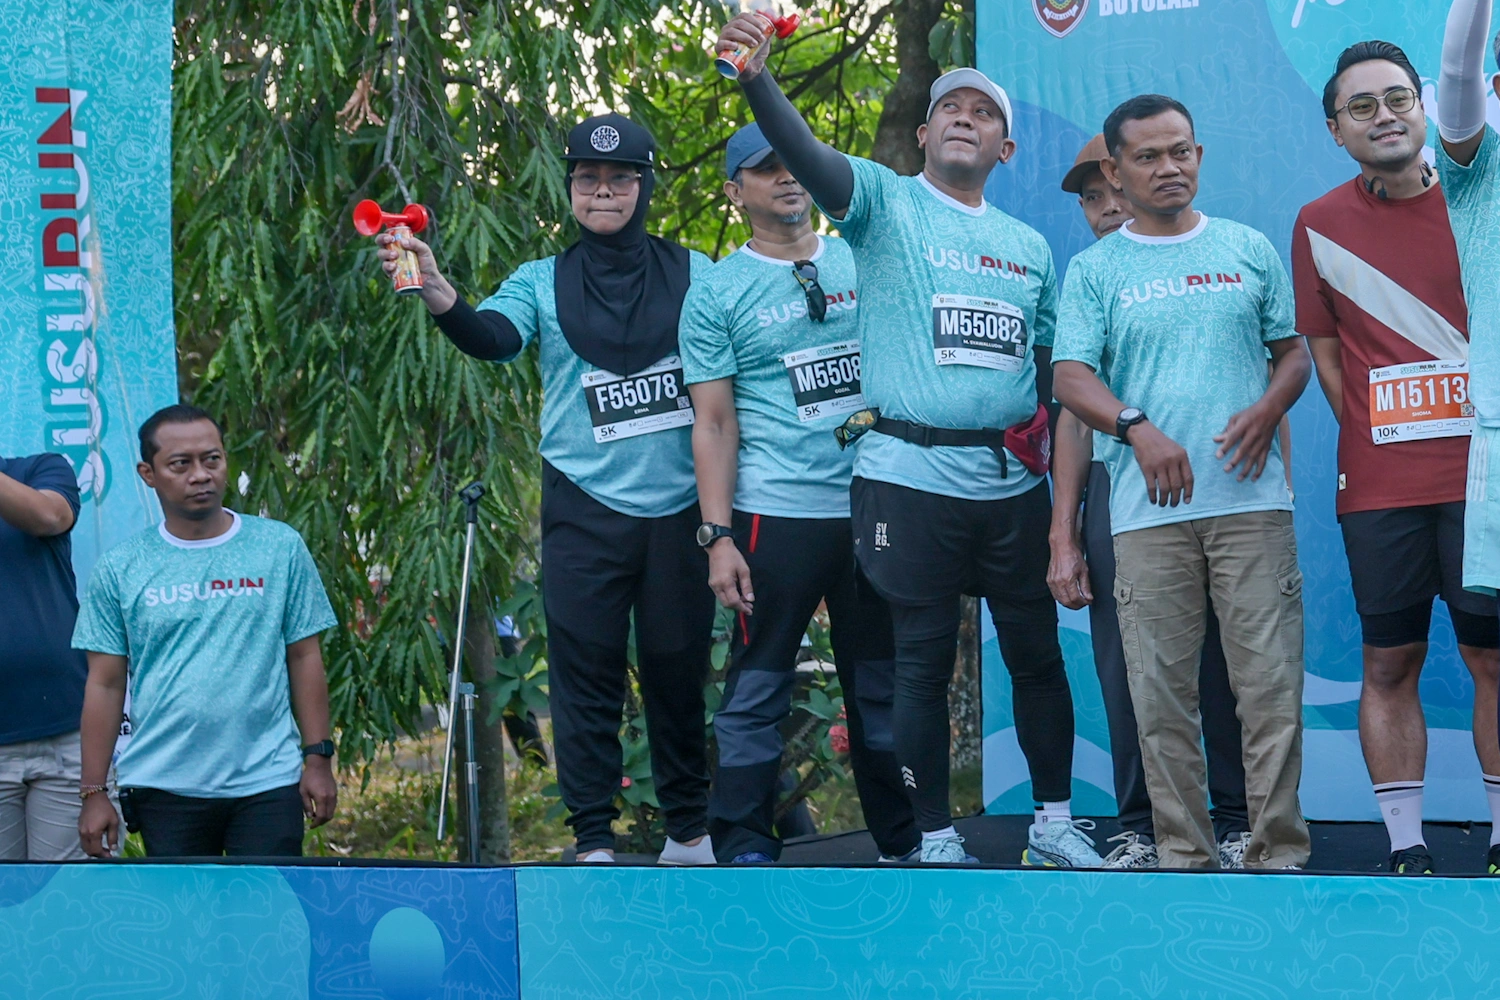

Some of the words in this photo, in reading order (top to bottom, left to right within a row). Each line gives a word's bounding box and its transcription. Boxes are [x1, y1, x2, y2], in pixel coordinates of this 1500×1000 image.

[1119, 272, 1245, 309] SUSURUN
[756, 289, 857, 328] SUSRU
[940, 309, 1022, 344] M55082
[941, 349, 957, 359] 5K
[794, 355, 860, 393] M5508
[1400, 364, 1437, 375] SUSURUN
[594, 373, 679, 413] F55078
[1376, 376, 1467, 412] M15113
[634, 407, 650, 415] ERMA
[804, 404, 821, 416] 5K
[600, 425, 618, 437] 5K
[1377, 426, 1399, 438] 10K
[143, 577, 265, 607] SUSURUN
